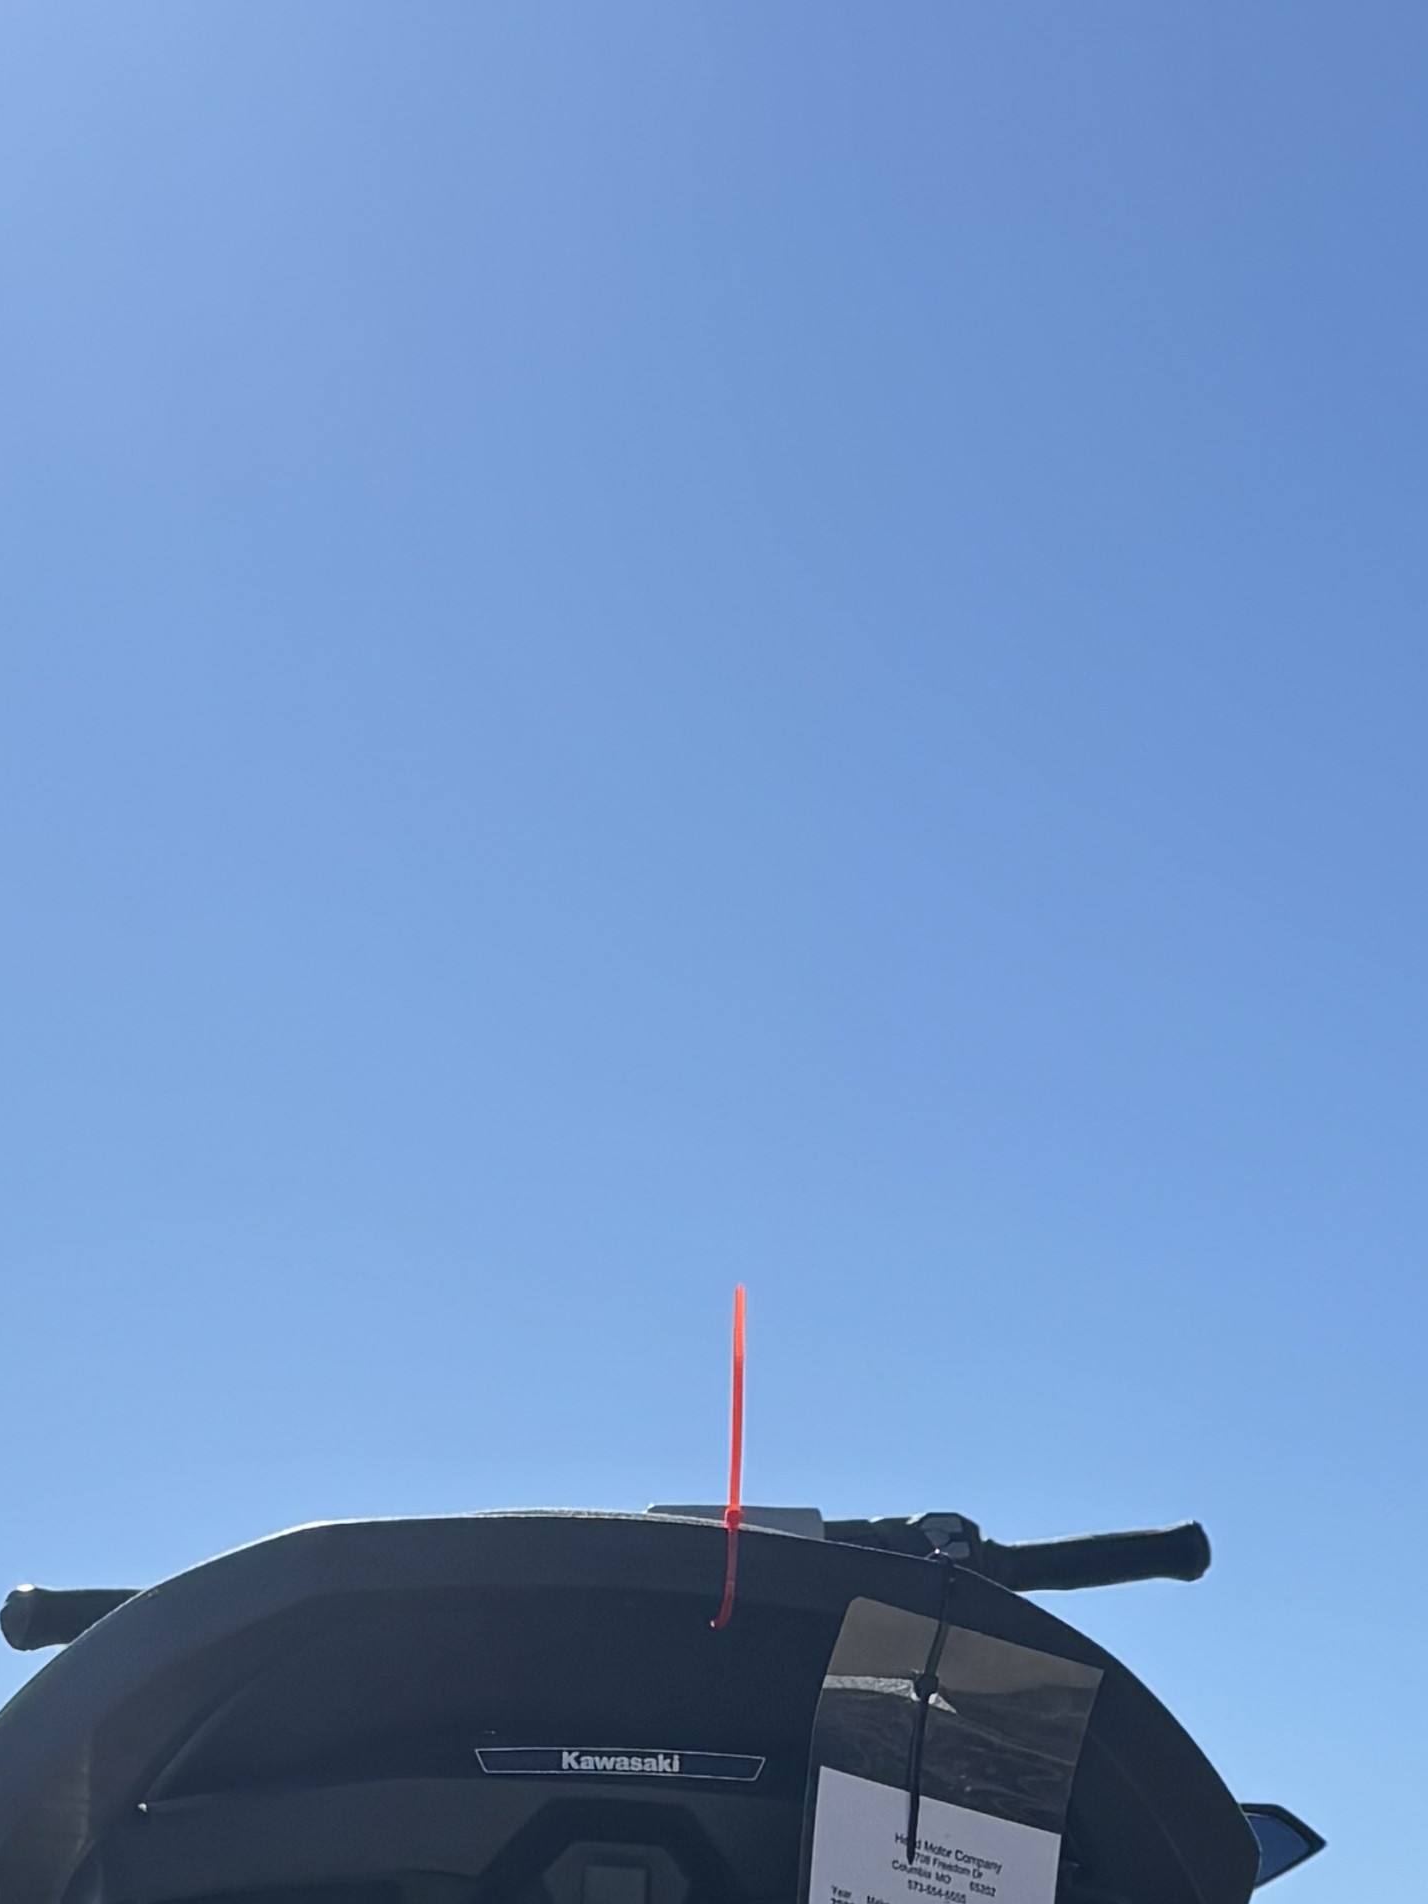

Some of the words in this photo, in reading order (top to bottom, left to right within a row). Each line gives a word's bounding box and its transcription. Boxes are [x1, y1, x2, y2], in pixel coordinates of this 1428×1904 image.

[561, 1750, 681, 1774] Kawasaki
[924, 1840, 951, 1858] Motor
[954, 1848, 1001, 1874] Company
[932, 1857, 970, 1876] Freedom
[892, 1860, 931, 1879] Columbia
[935, 1872, 950, 1884] MO
[831, 1884, 851, 1898] Year
